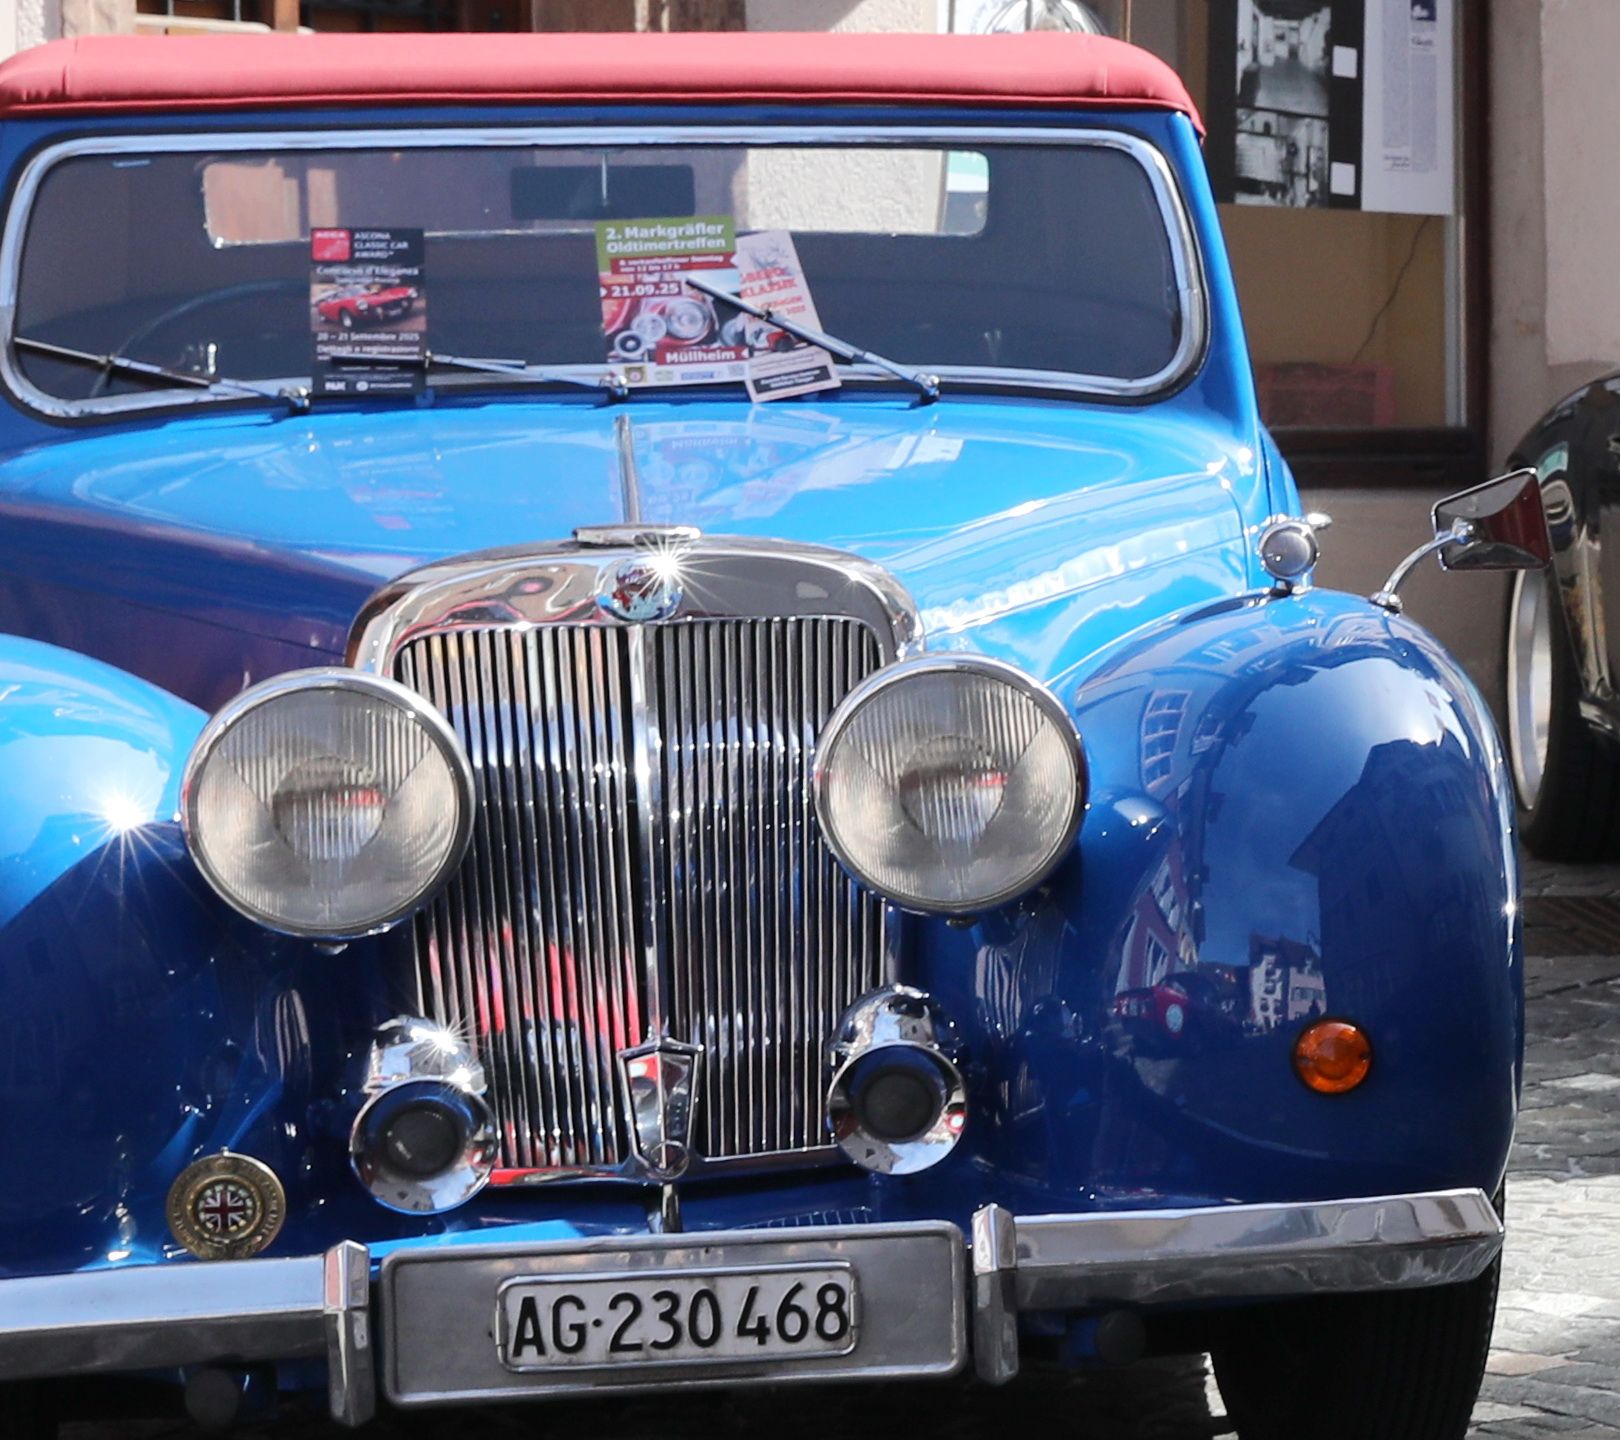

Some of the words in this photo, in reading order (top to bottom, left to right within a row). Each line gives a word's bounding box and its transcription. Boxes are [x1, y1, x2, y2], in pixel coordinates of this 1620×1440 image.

[354, 232, 391, 240] ASCONA
[606, 228, 622, 240] 2.
[625, 222, 724, 239] Markgräfler
[354, 242, 388, 250] CLASSIC
[390, 242, 409, 250] CAR
[606, 238, 726, 253] Oldtimertreffen
[611, 282, 680, 297] 21.09.25
[665, 349, 736, 363] Müllheim
